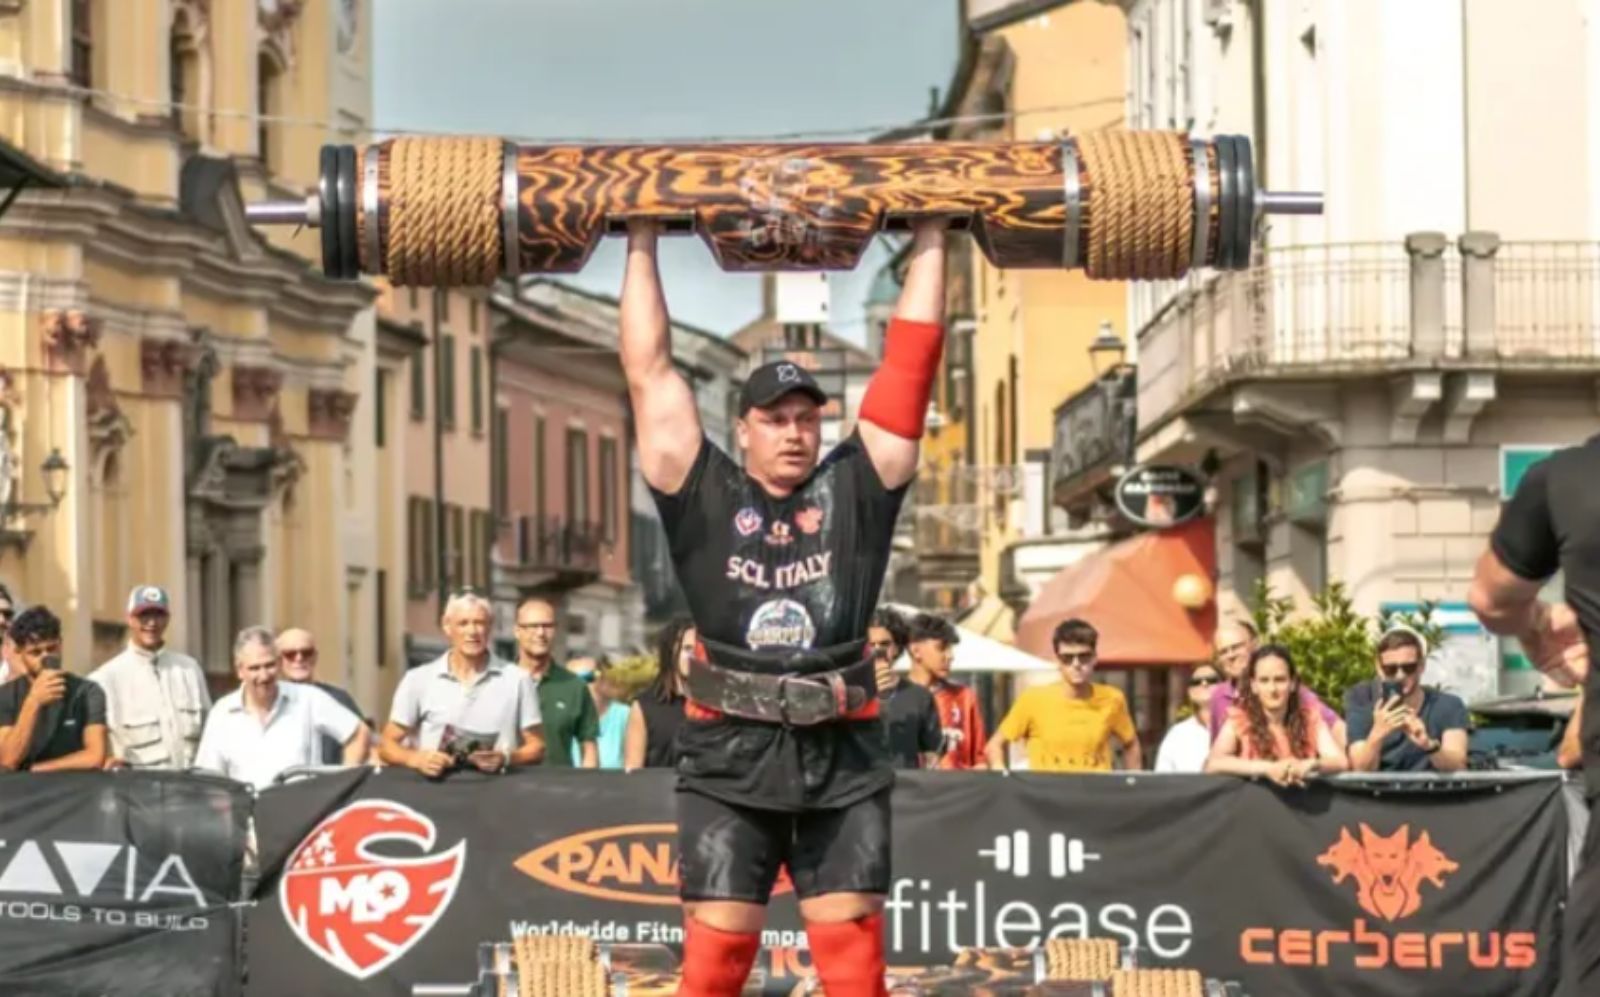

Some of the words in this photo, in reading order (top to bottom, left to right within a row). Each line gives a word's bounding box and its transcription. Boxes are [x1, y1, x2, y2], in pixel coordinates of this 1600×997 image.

[726, 556, 770, 589] SCL
[775, 550, 832, 589] ITALY
[0, 840, 208, 908] AVIA
[556, 842, 679, 885] PAN
[90, 907, 126, 926] TO
[510, 920, 629, 941] Worldwide
[637, 921, 686, 942] Fitn
[884, 878, 1193, 957] fitlease
